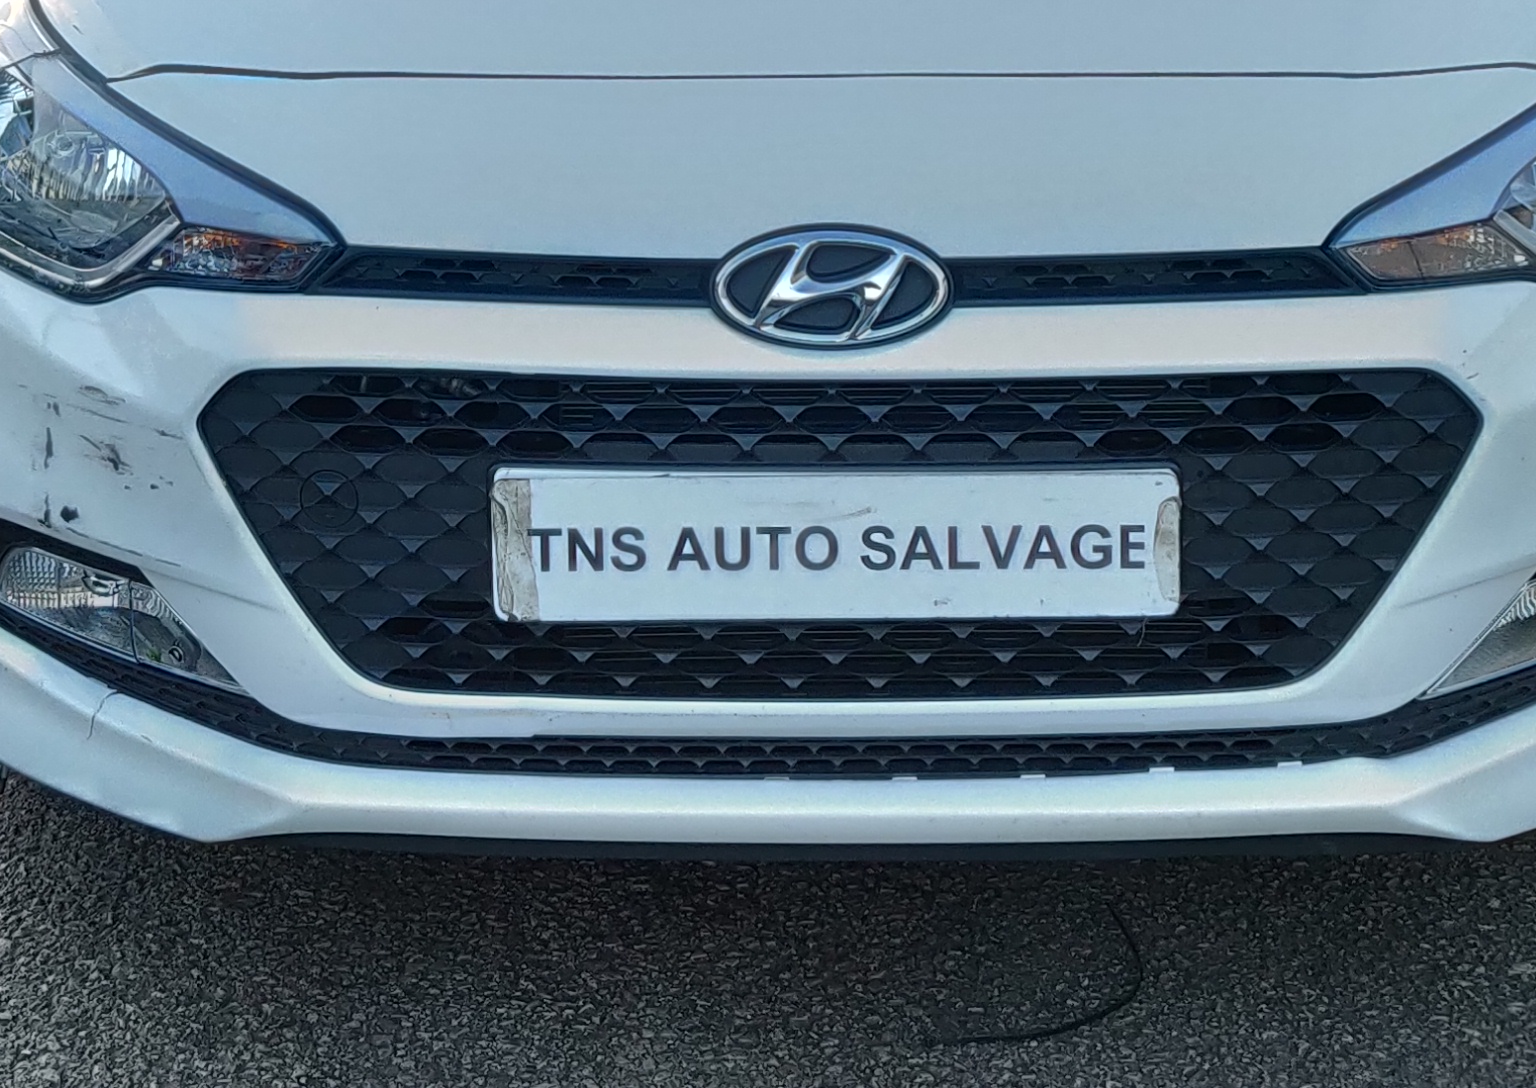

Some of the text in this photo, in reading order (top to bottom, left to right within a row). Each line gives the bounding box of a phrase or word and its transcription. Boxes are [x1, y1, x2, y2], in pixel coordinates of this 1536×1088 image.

[528, 524, 1146, 573] TNS AUTO SALVAGE
